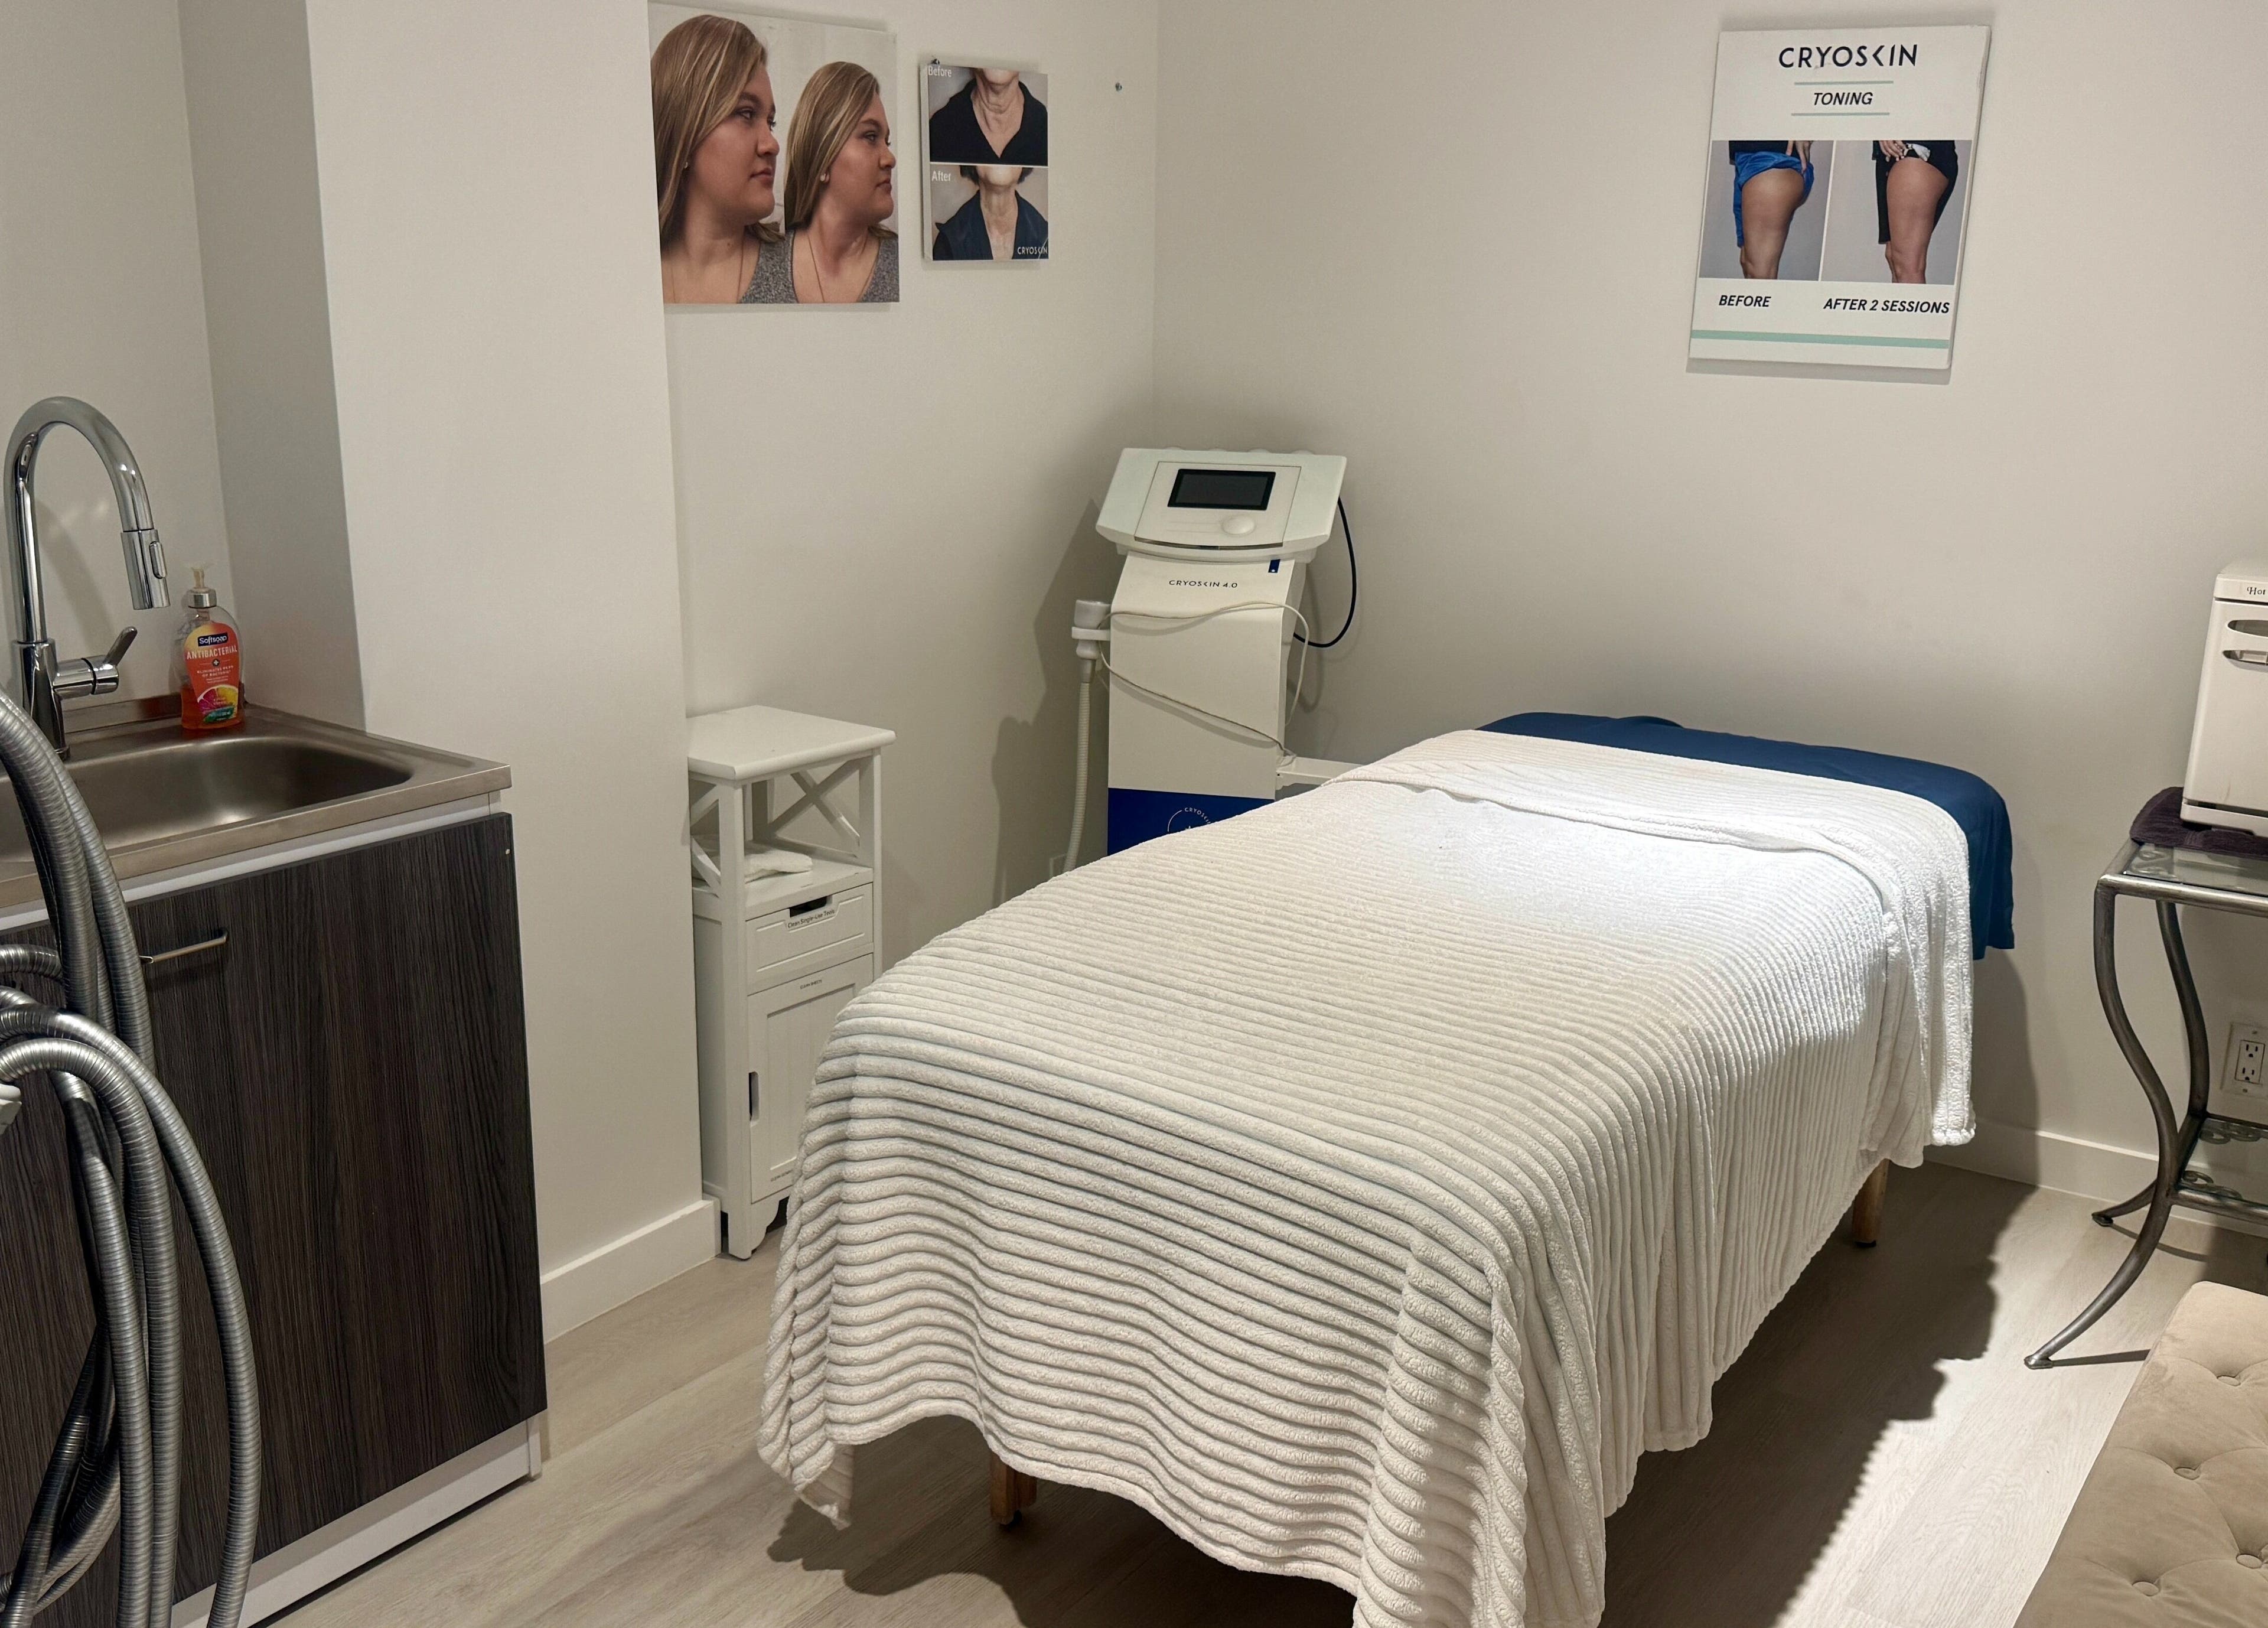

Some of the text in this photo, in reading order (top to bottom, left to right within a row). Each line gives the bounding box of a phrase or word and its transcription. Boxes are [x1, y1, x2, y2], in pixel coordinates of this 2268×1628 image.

[1778, 44, 1918, 68] CRYOSKIN
[928, 65, 952, 77] Before
[1813, 92, 1873, 106] TONING
[931, 170, 951, 181] After
[1718, 295, 1771, 307] BEFORE
[1823, 298, 1950, 313] AFTER 2 SESSIONS
[199, 636, 227, 644] Softsoap
[187, 644, 237, 659] ANTIBACTERIAL
